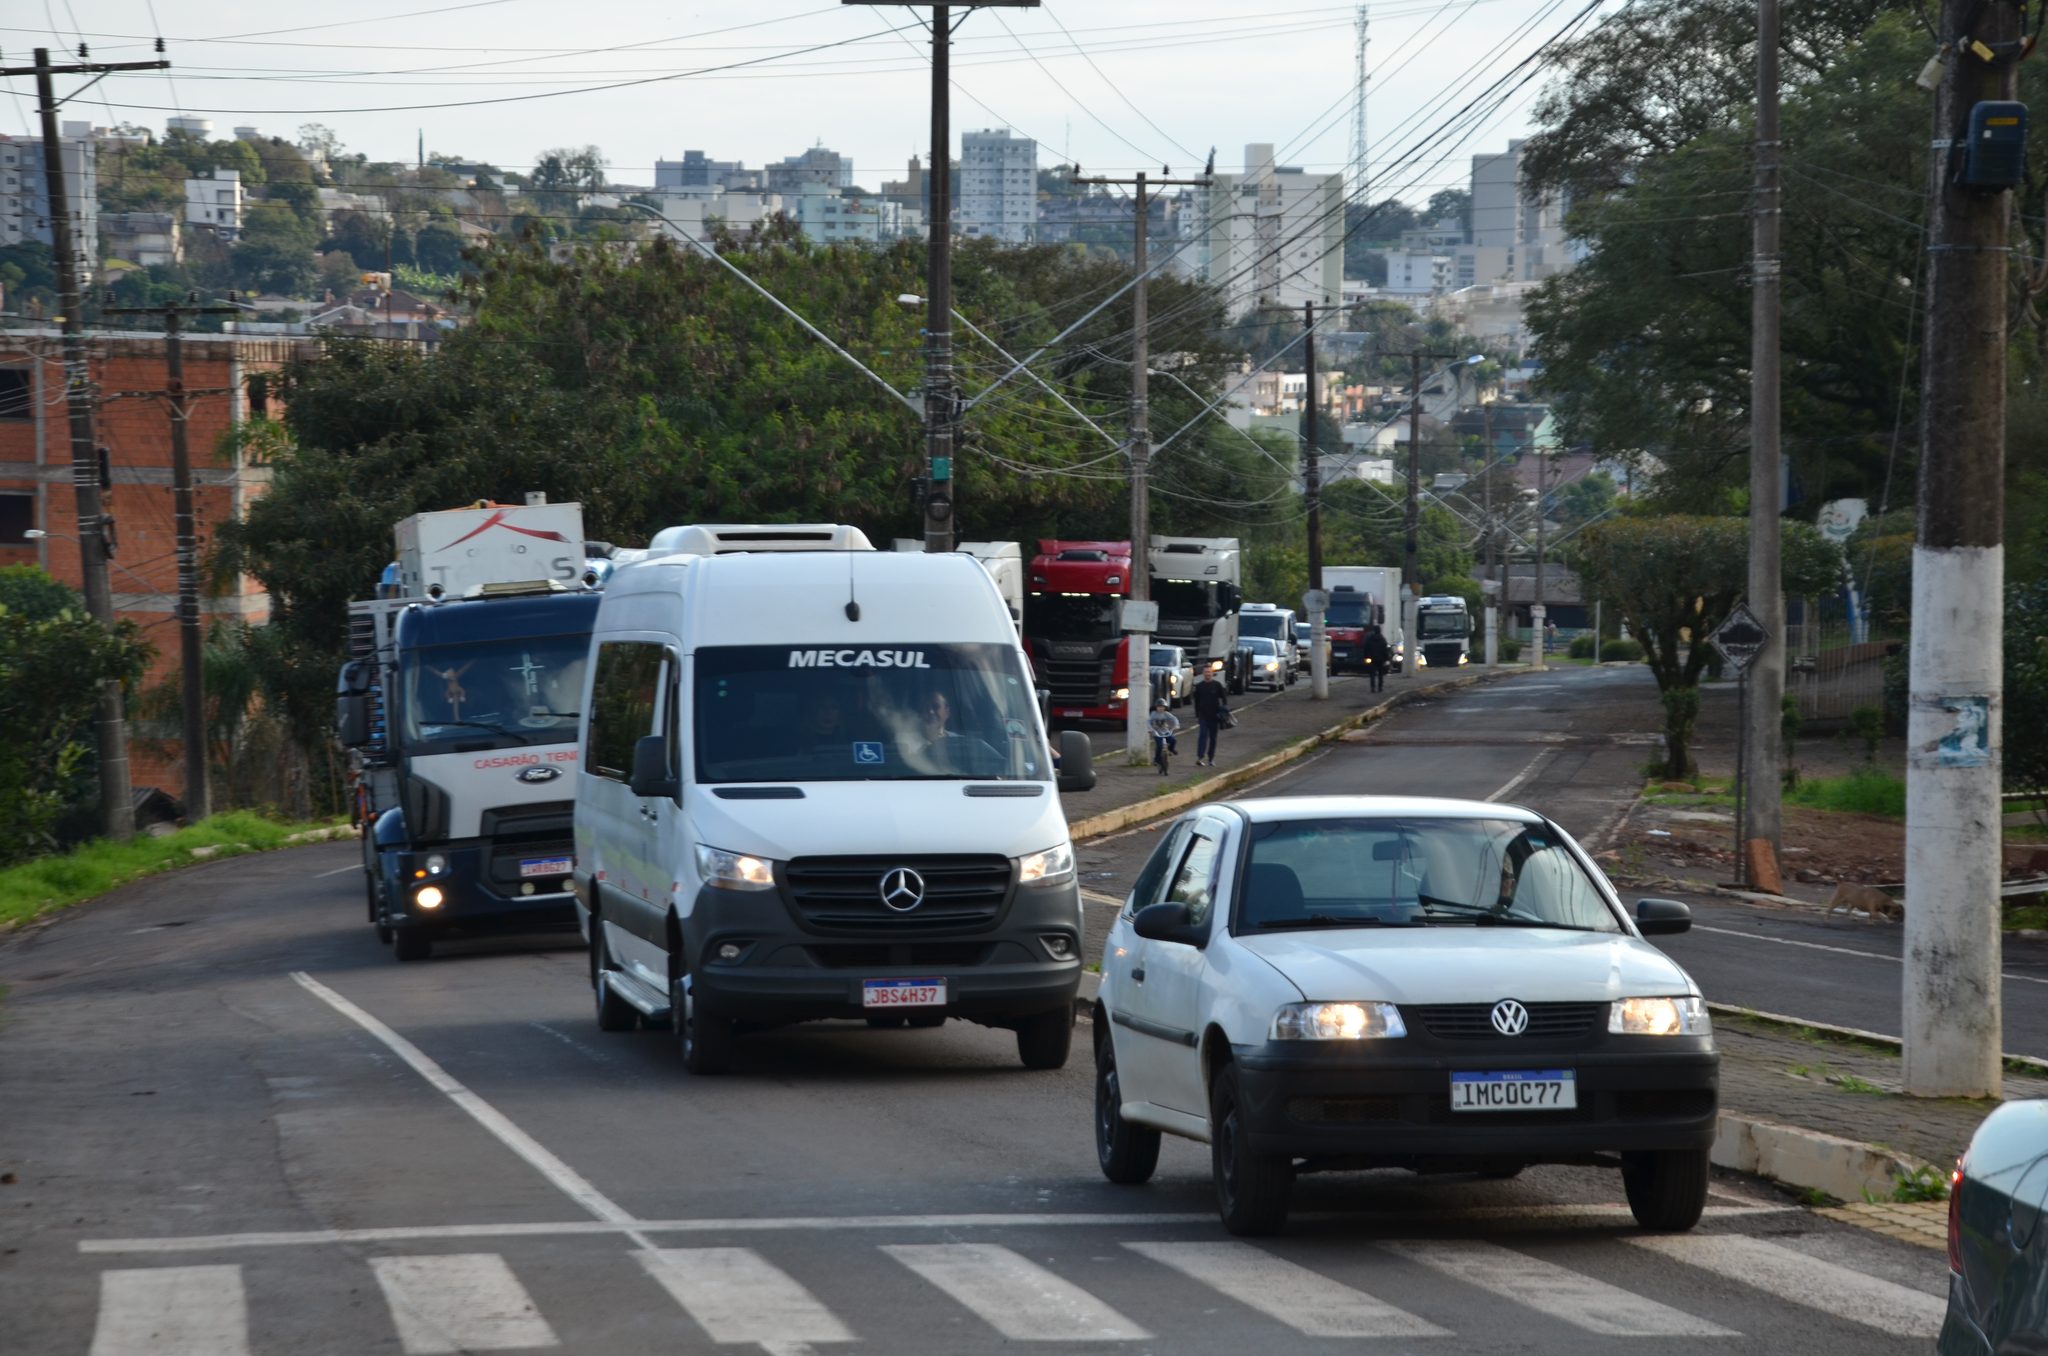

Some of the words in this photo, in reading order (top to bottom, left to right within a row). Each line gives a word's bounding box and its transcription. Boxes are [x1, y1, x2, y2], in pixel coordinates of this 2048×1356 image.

[788, 650, 931, 668] MECASUL
[474, 753, 539, 769] CASARÃO
[872, 988, 937, 1004] JBS4H37
